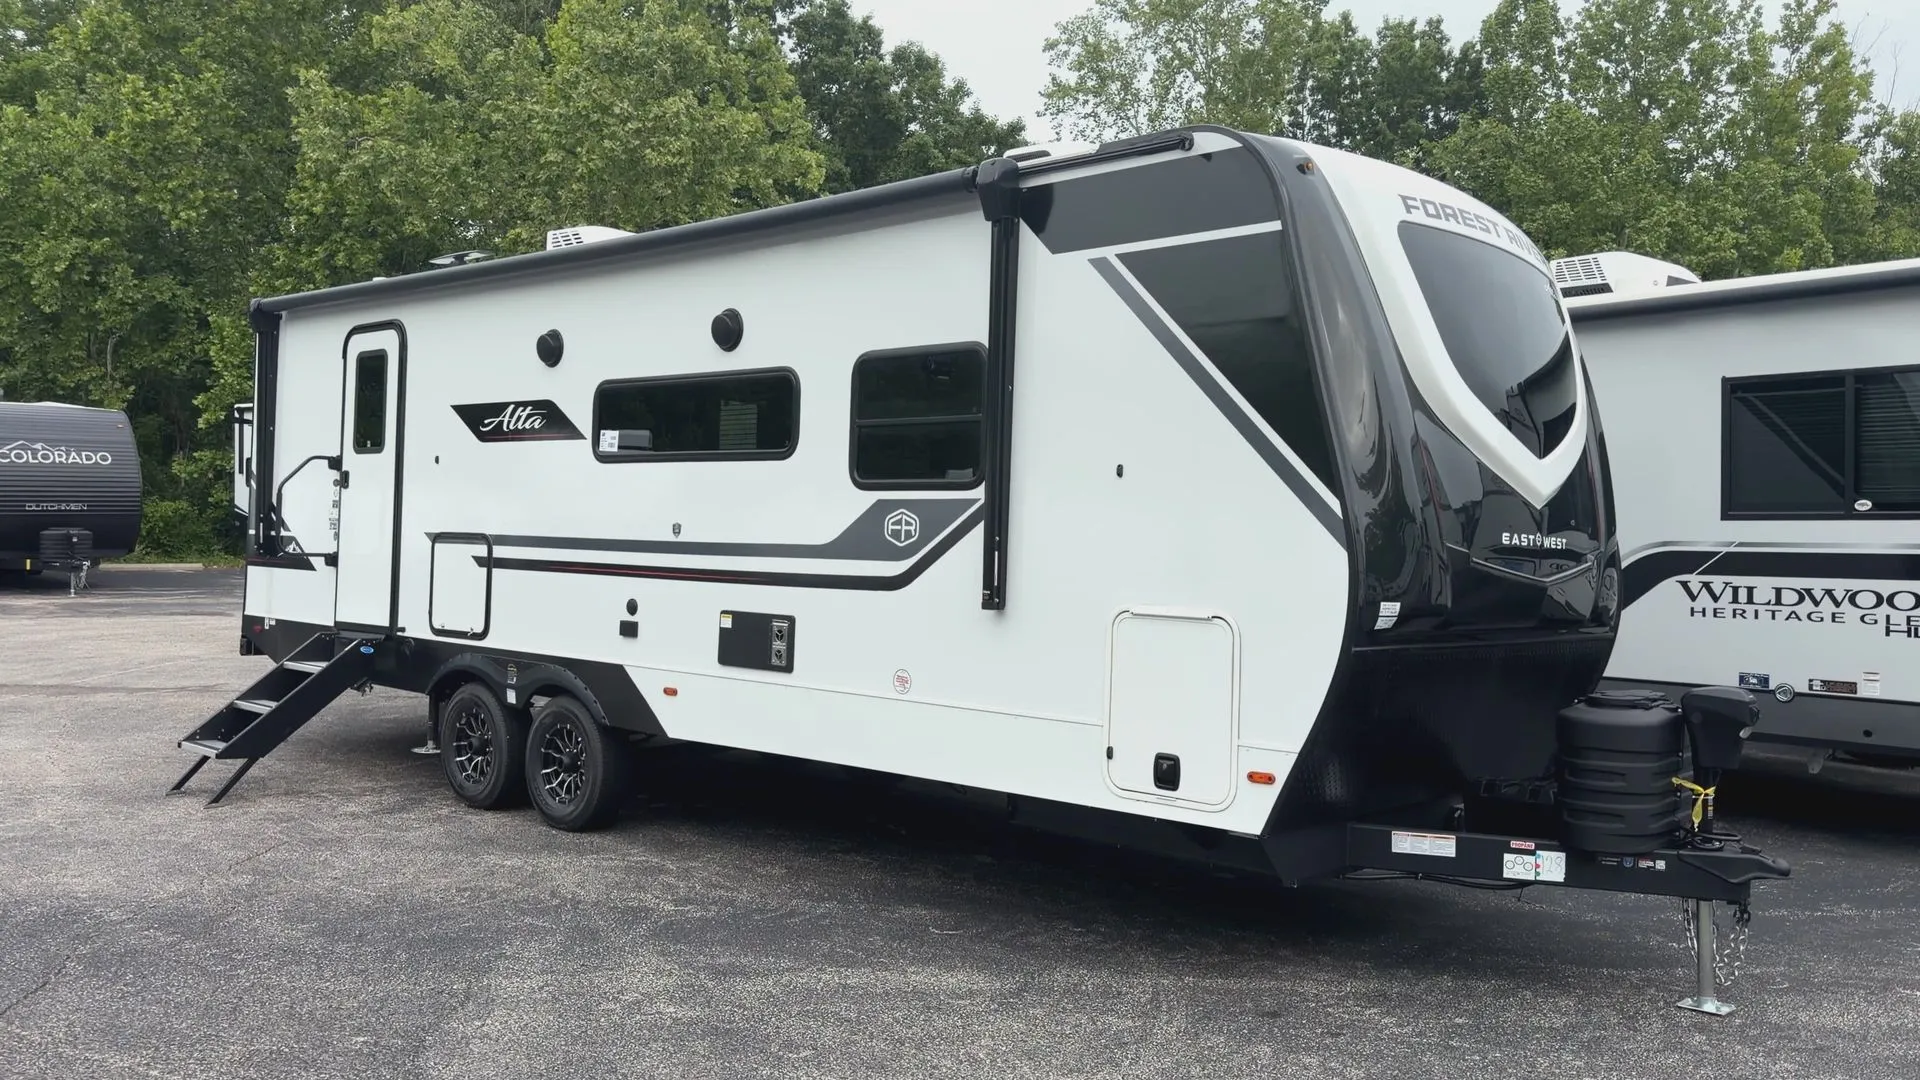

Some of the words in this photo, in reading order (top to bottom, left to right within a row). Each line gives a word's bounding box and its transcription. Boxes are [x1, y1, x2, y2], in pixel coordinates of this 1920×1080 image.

[1398, 194, 1501, 238] FOREST
[480, 404, 547, 431] Alta
[0, 449, 112, 465] COLORADO
[1502, 532, 1535, 546] EAST
[1543, 536, 1567, 549] WEST
[1690, 606, 1846, 624] HERITAGE
[1511, 841, 1534, 849] PROPANE
